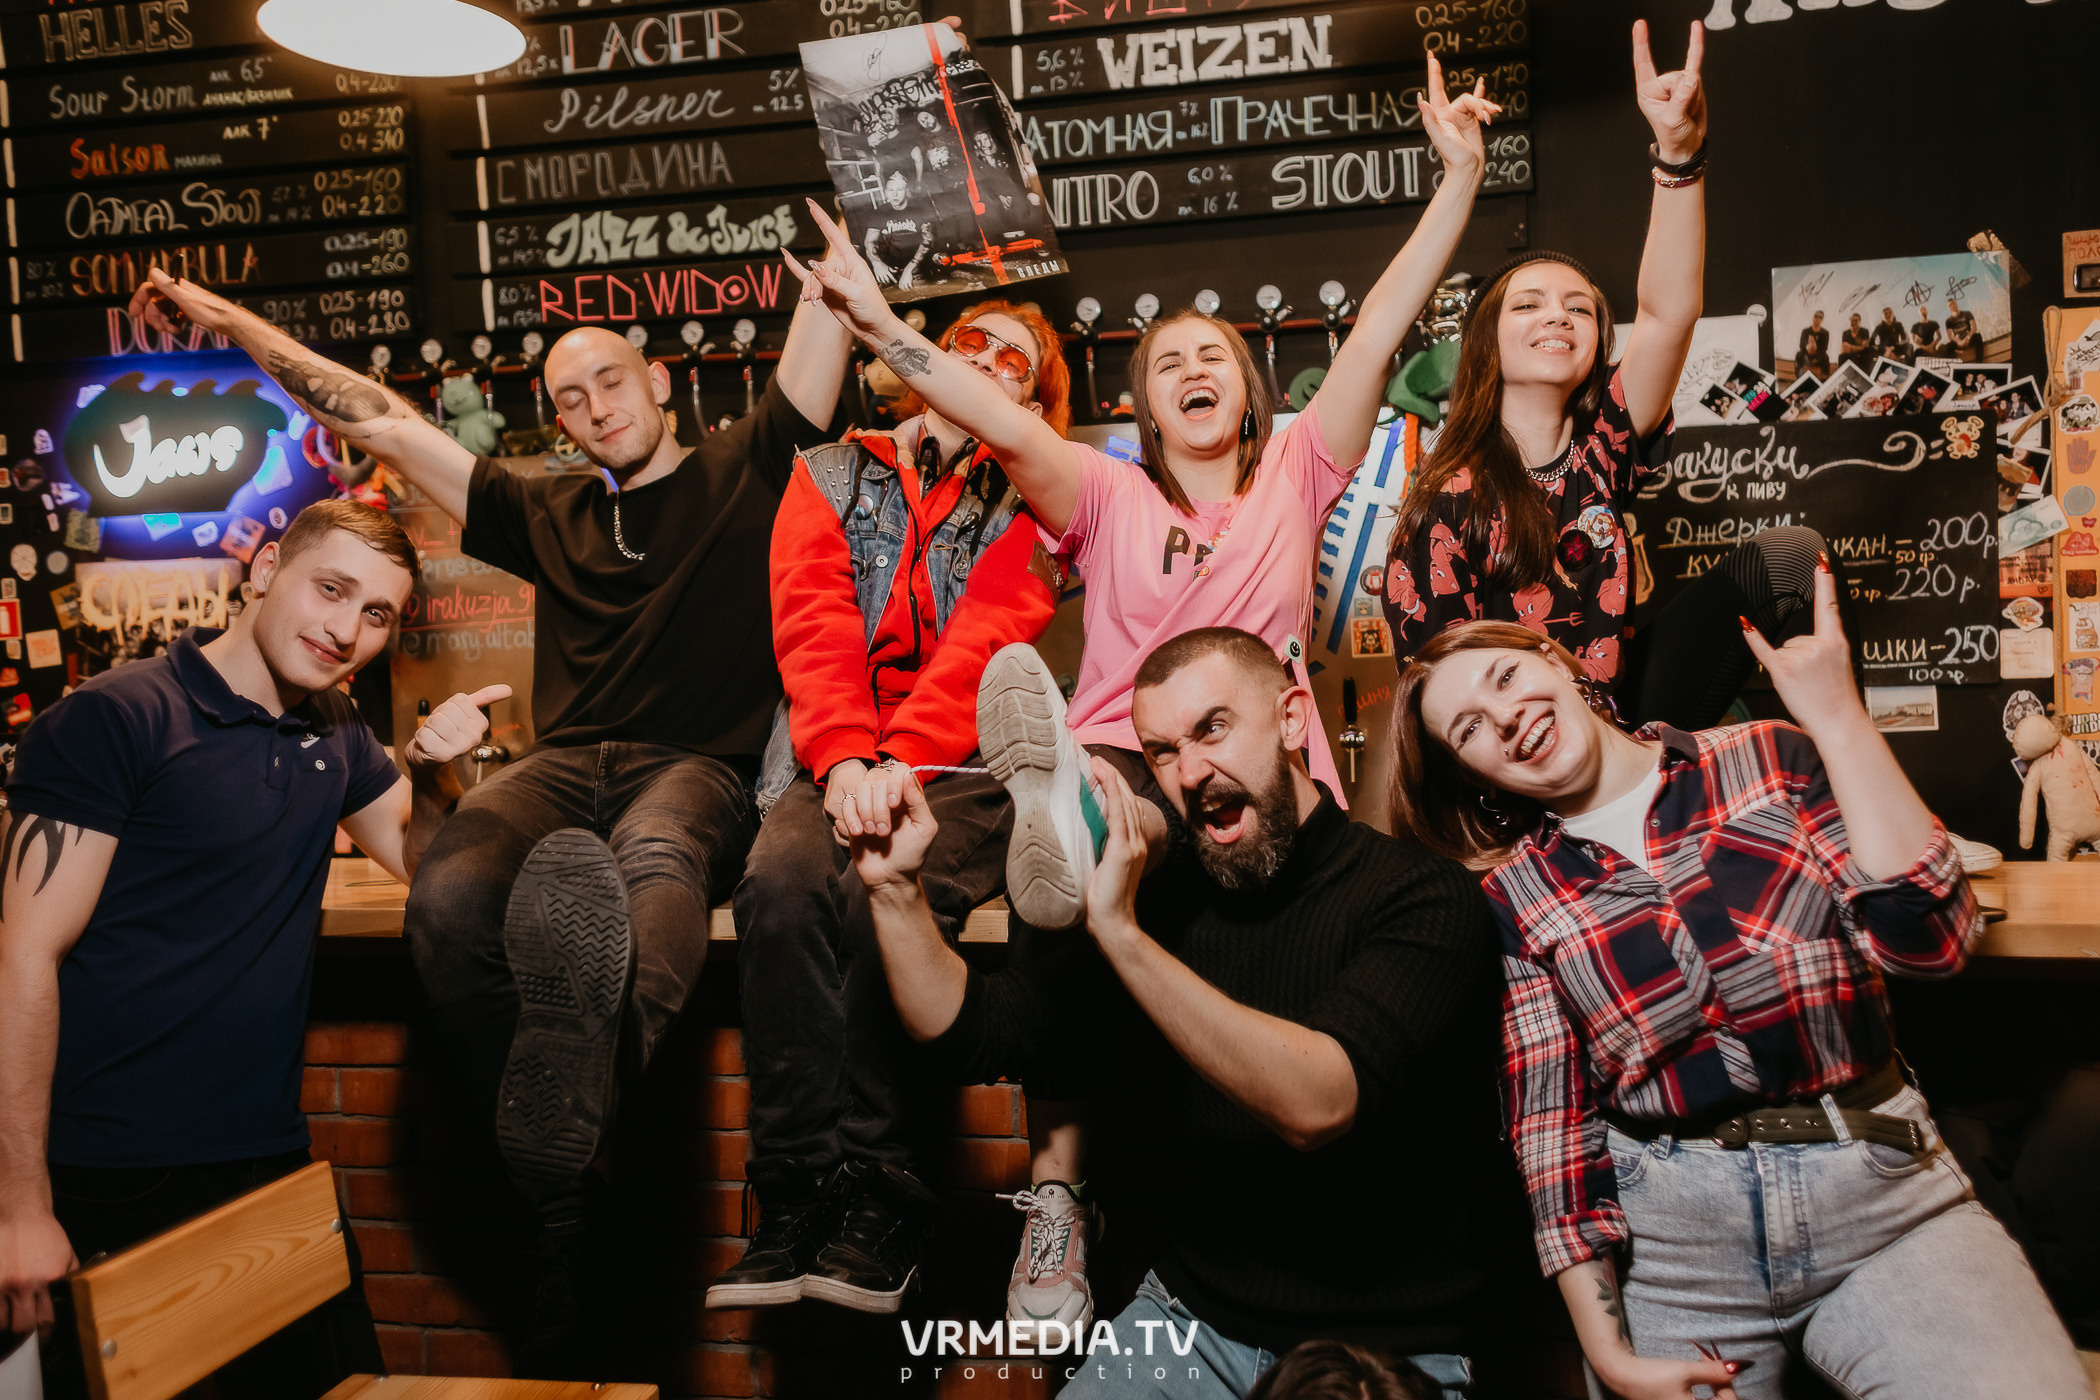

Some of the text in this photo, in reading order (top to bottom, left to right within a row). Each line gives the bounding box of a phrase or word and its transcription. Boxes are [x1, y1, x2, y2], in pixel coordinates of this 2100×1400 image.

[38, 0, 194, 63] HELLES
[558, 8, 747, 75] LAGER
[1096, 14, 1333, 90] WEIZEN
[48, 76, 198, 120] Sour Storm
[543, 86, 736, 134] Pilsner
[1025, 86, 1427, 161] АТОМНАЯ ПРАЧЕЧНАЯ
[70, 138, 170, 180] Saison
[496, 140, 734, 205] СМОРОДИНА
[1271, 146, 1425, 210] STOUT
[545, 210, 660, 269] JAZZ
[666, 211, 711, 255] &
[539, 263, 783, 323] RED WIDOW
[93, 414, 244, 498] Jaws
[1886, 563, 1956, 601] 220
[1908, 667, 1944, 682] 100
